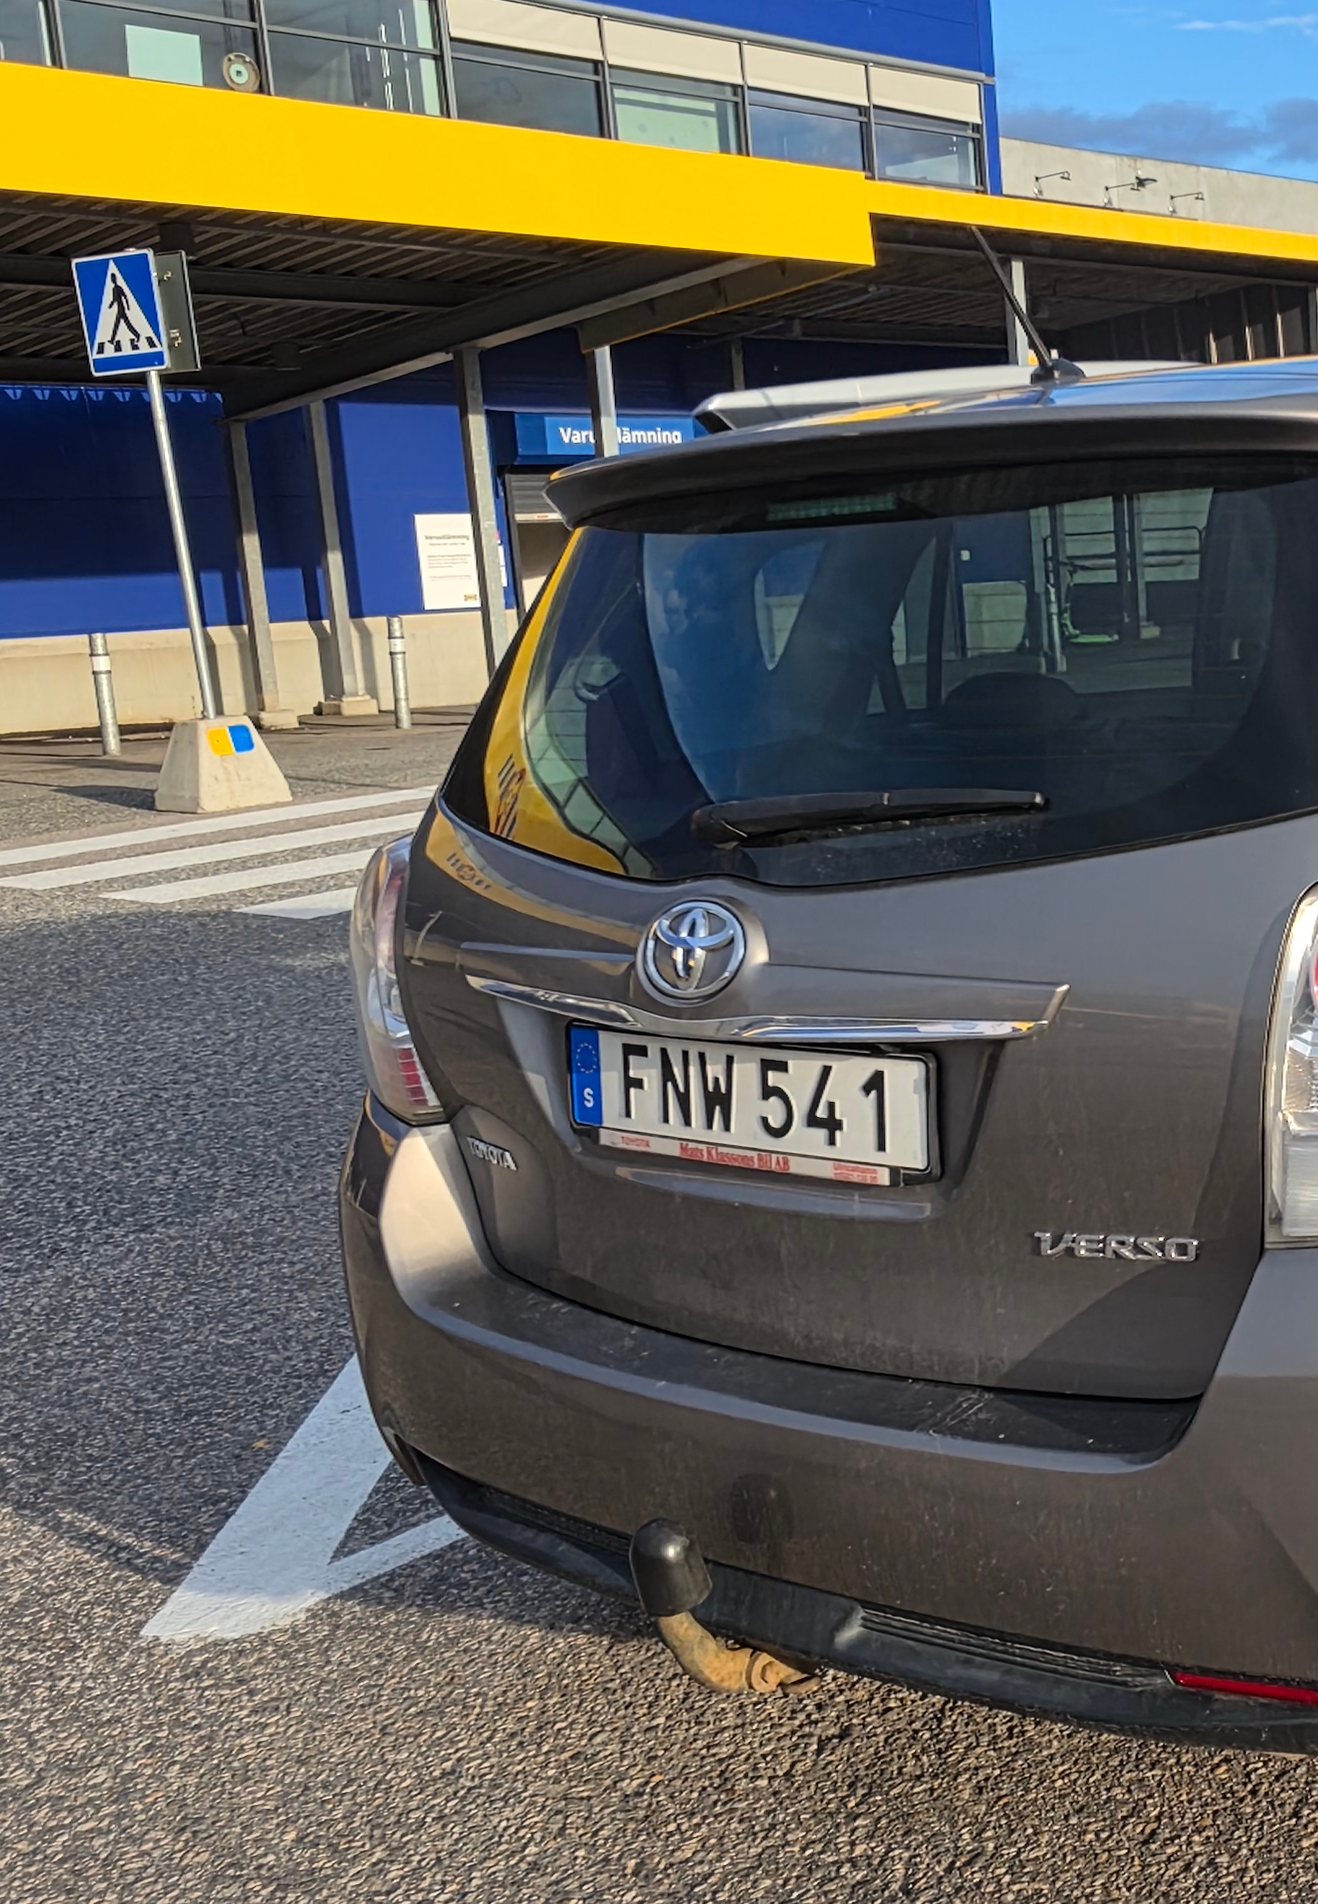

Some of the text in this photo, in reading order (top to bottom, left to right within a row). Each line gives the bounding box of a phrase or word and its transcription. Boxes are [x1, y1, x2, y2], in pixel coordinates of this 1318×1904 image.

[559, 427, 682, 444] Varulämning
[584, 1087, 594, 1108] S
[621, 1042, 887, 1153] FNW 541
[466, 1136, 518, 1171] TOYOTA
[774, 1156, 790, 1172] AB
[1034, 1231, 1199, 1262] VERSO
